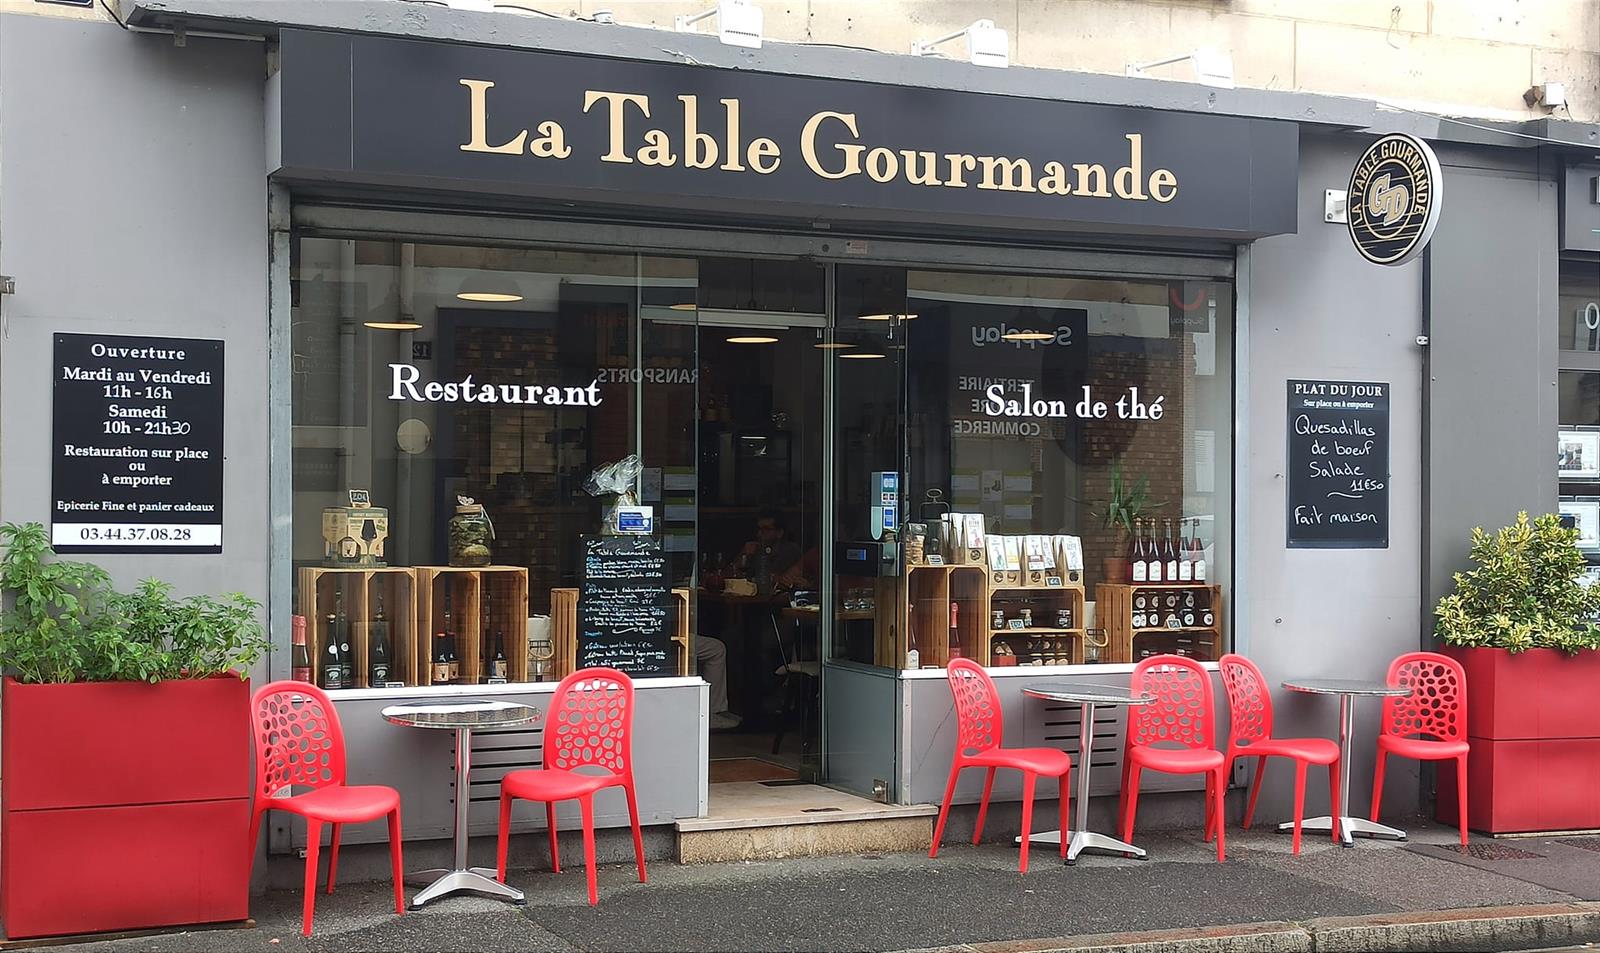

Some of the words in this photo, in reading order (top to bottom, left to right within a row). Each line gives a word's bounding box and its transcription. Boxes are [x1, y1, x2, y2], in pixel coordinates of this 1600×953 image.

[459, 78, 573, 159] La
[583, 90, 782, 175] Table
[800, 110, 1178, 203] Gourmande
[1352, 150, 1380, 197] TABLE
[1381, 141, 1427, 215] GOURMANDE
[1352, 203, 1363, 225] LA
[91, 343, 186, 360] Ouverture
[63, 367, 113, 381] Mardi
[116, 371, 135, 382] au
[139, 369, 212, 385] Vendredi
[103, 385, 131, 398] 11h
[145, 386, 172, 400] 16h
[387, 363, 603, 407] Restaurant
[1295, 383, 1326, 395] PLAT
[1330, 385, 1348, 395] DU
[1351, 385, 1383, 398] JOUR
[985, 384, 1067, 418] Salon
[1075, 385, 1108, 419] de
[1115, 386, 1165, 420] thé
[1303, 399, 1315, 407] Sur
[1316, 400, 1332, 408] place
[1347, 401, 1374, 410] emporter
[108, 404, 167, 419] Samedi
[103, 420, 131, 434] 10h
[144, 421, 191, 436] 21h30
[1295, 414, 1376, 436] Quesadillas
[64, 444, 148, 457] Restauration
[151, 448, 173, 458] sur
[175, 447, 209, 461] place
[1311, 439, 1329, 455] de
[128, 461, 146, 472] ou
[1310, 461, 1364, 478] Salade
[102, 473, 109, 485] à
[113, 474, 173, 488] emporter
[1350, 479, 1385, 492] 11€50
[57, 501, 100, 513] Epicerie
[102, 501, 125, 511] Fine
[127, 503, 136, 511] et
[139, 502, 172, 513] panier
[174, 502, 214, 512] cadeaux
[1294, 505, 1323, 525] Fait
[1330, 511, 1378, 524] maison
[80, 528, 192, 541] 03.44.37.08.28
